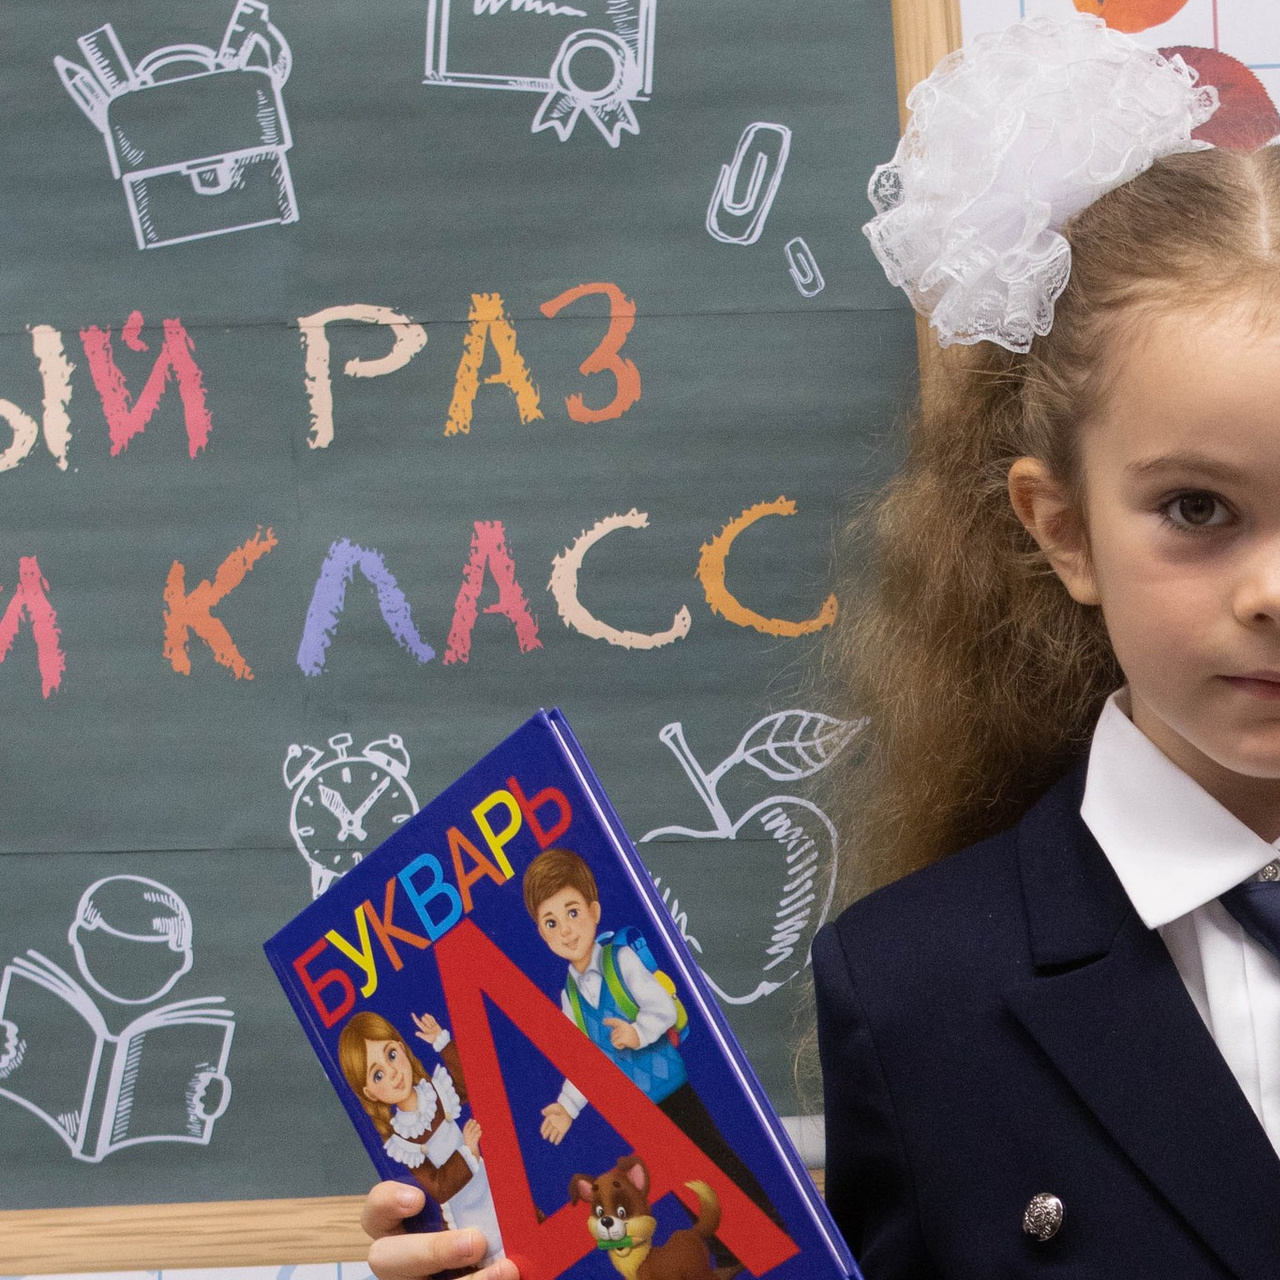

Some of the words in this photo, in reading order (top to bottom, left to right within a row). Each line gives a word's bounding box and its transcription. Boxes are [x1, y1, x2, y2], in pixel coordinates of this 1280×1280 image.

[297, 282, 642, 449] РАЗ
[162, 496, 839, 681] КЛАСС
[292, 777, 572, 1028] БУКВАРЬ
